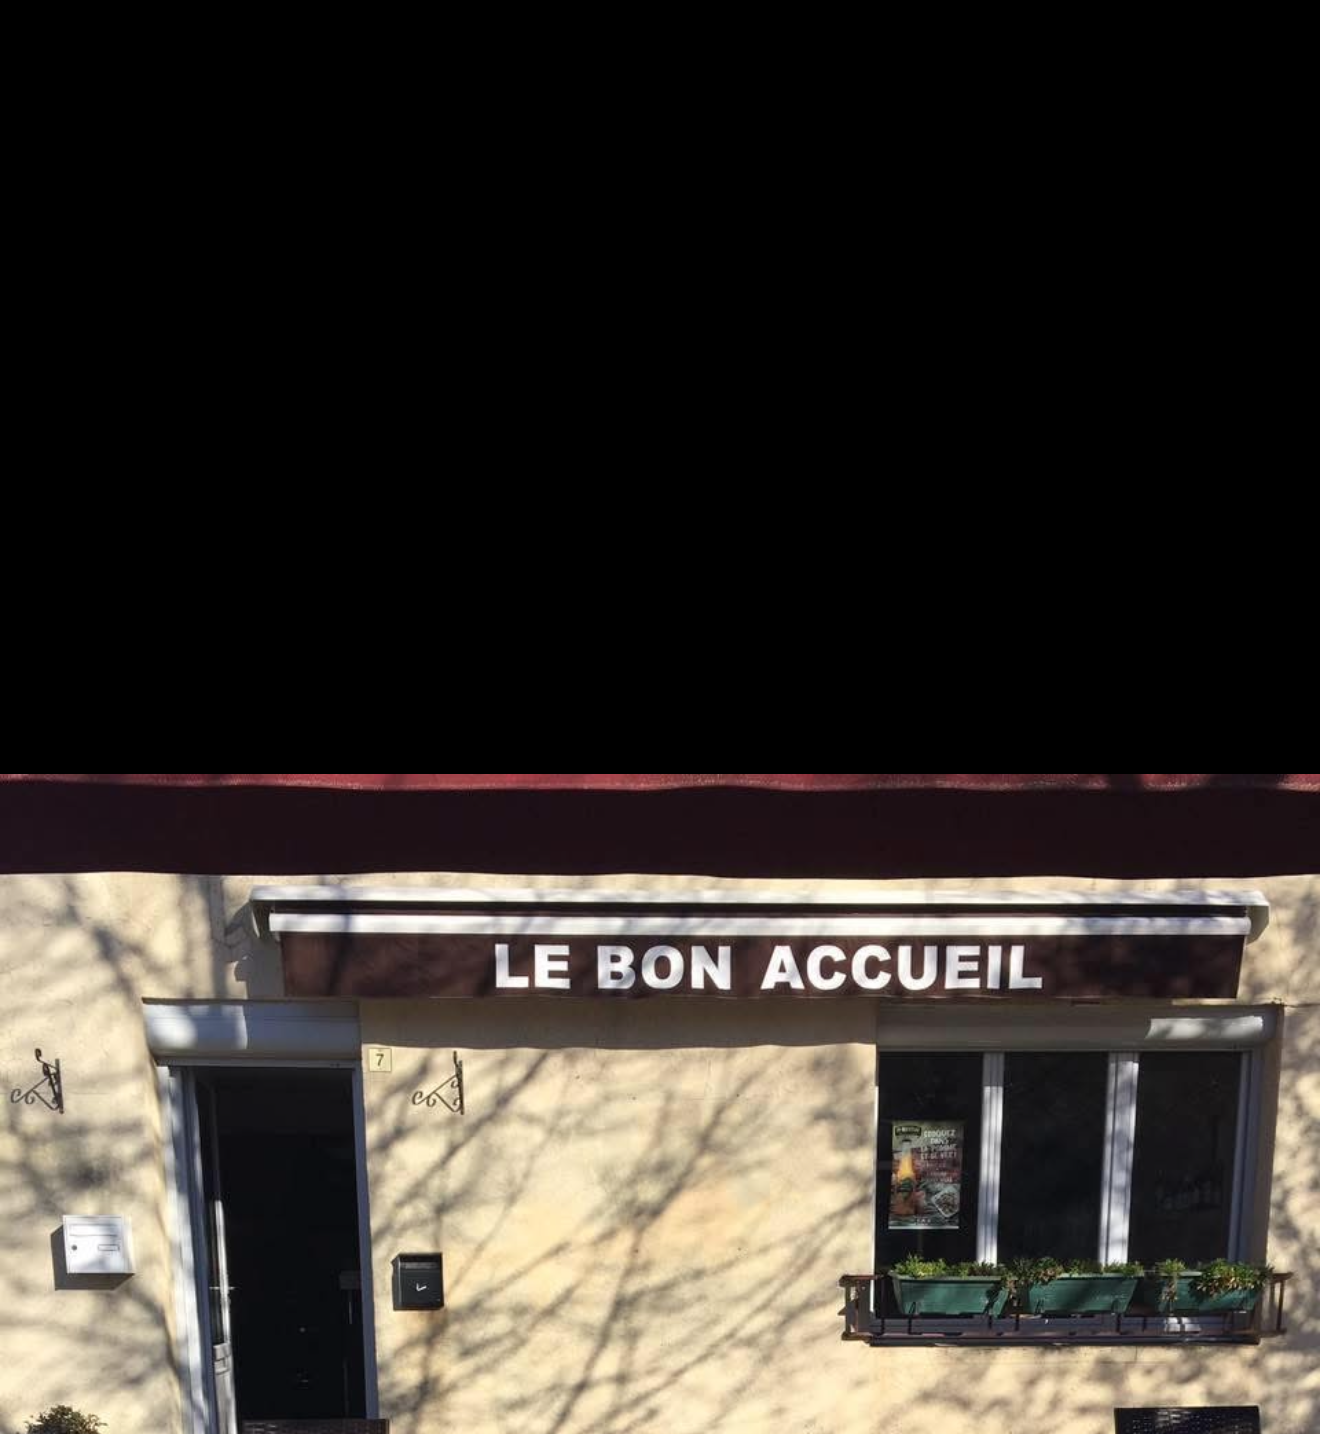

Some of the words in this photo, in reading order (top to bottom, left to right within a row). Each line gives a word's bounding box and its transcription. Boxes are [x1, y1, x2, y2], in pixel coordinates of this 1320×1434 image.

[494, 943, 571, 989] LE
[597, 944, 731, 991] BON
[760, 944, 1043, 991] ACCUEIL
[375, 1053, 385, 1067] 7
